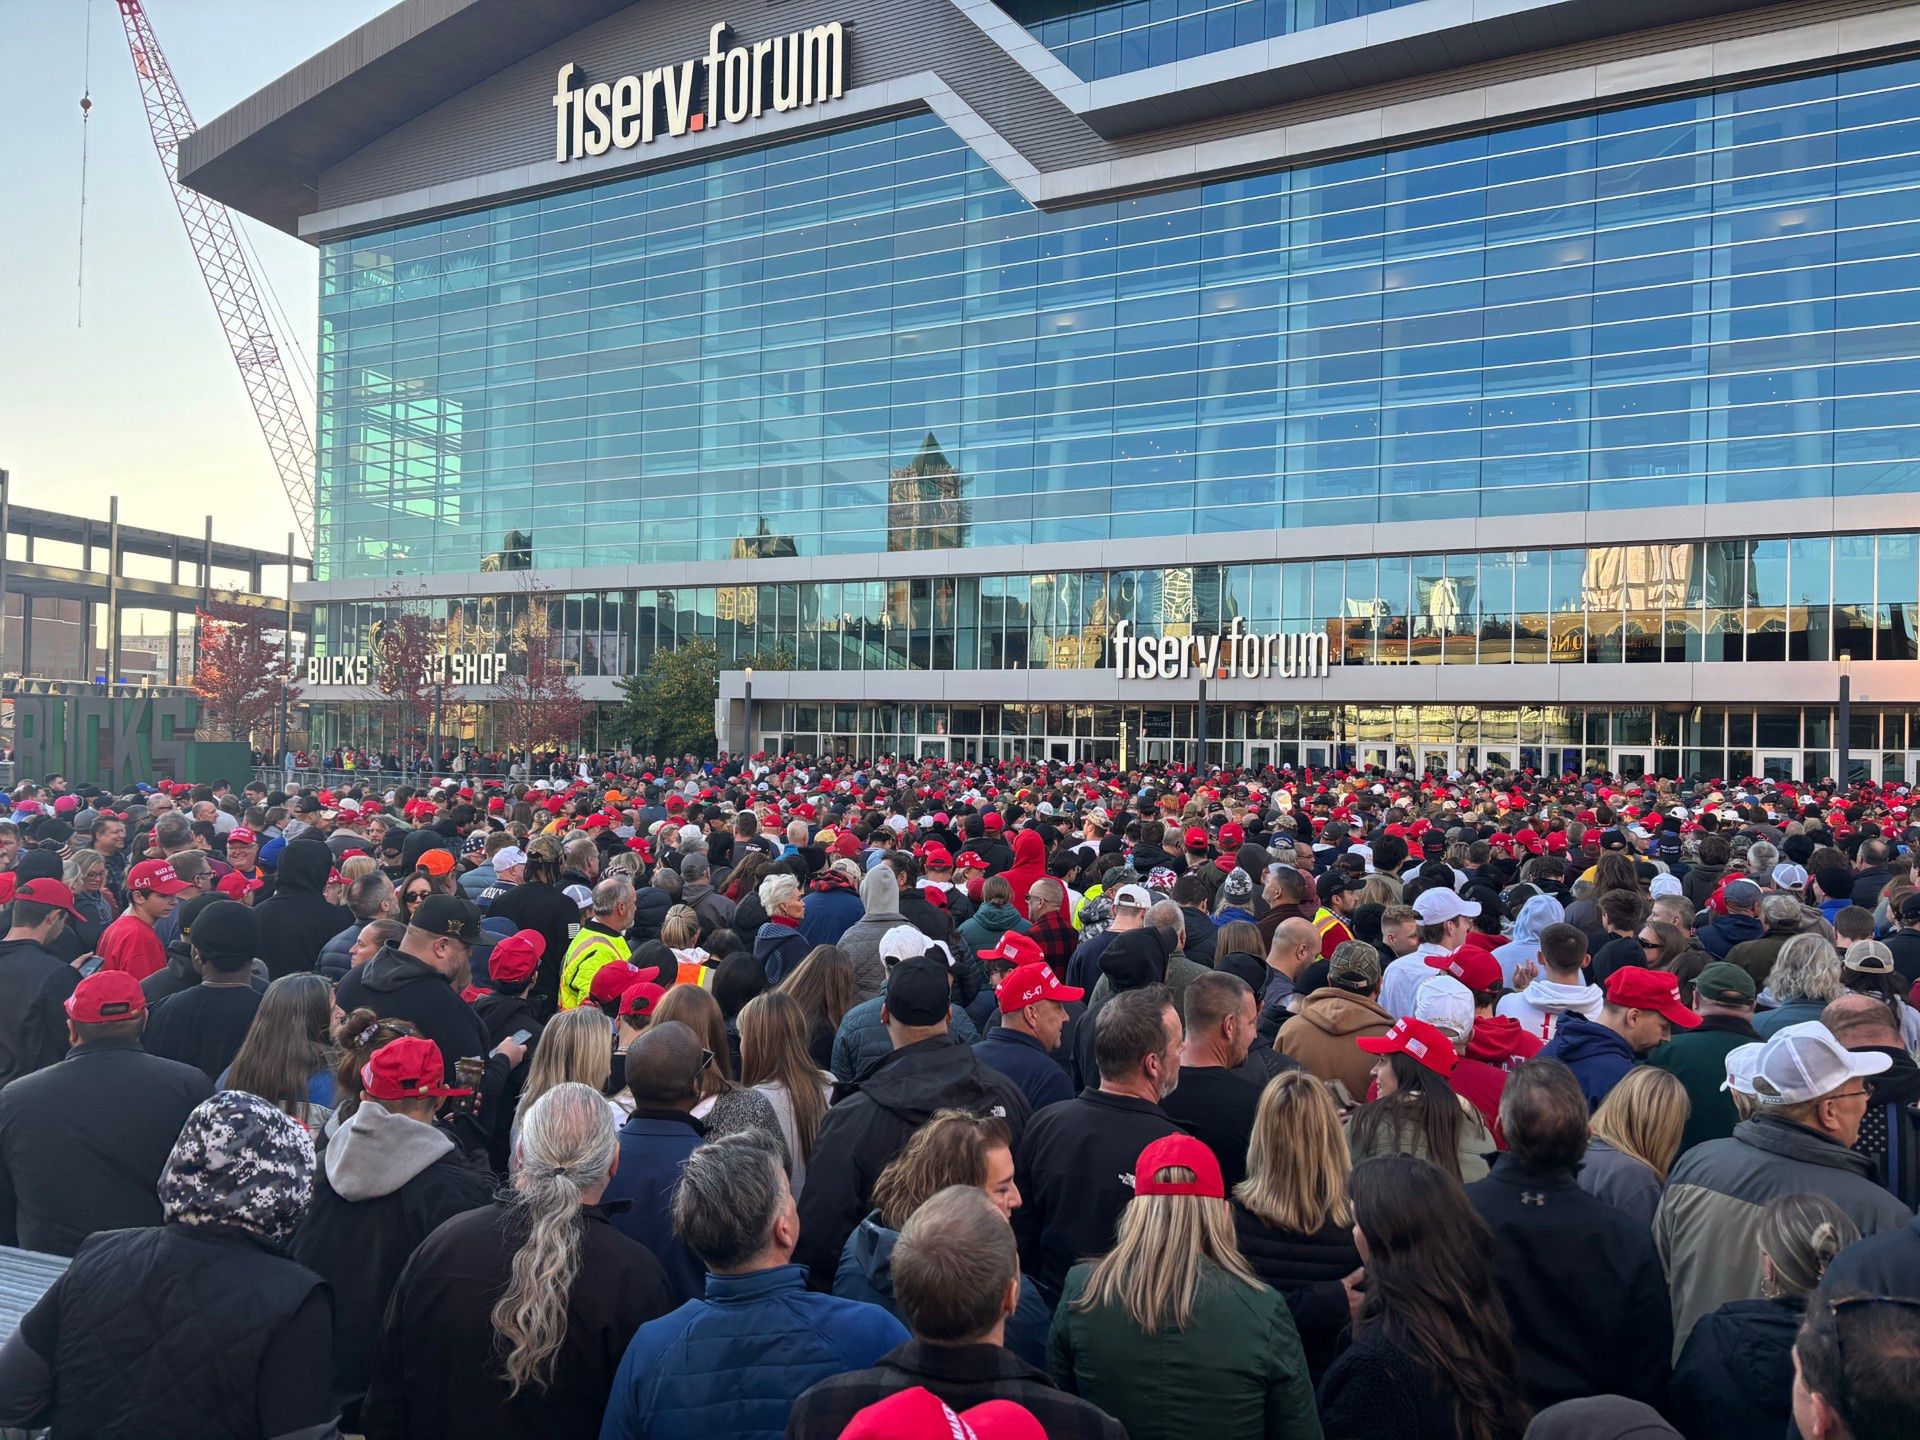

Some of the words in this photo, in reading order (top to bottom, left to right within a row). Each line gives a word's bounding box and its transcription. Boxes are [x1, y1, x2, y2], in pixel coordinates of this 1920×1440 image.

[553, 21, 845, 163] fiserv.forum
[308, 656, 369, 685] BUCKS
[452, 653, 507, 685] SHOP
[14, 697, 186, 787] BUCKS
[1022, 985, 1043, 1001] 45-47
